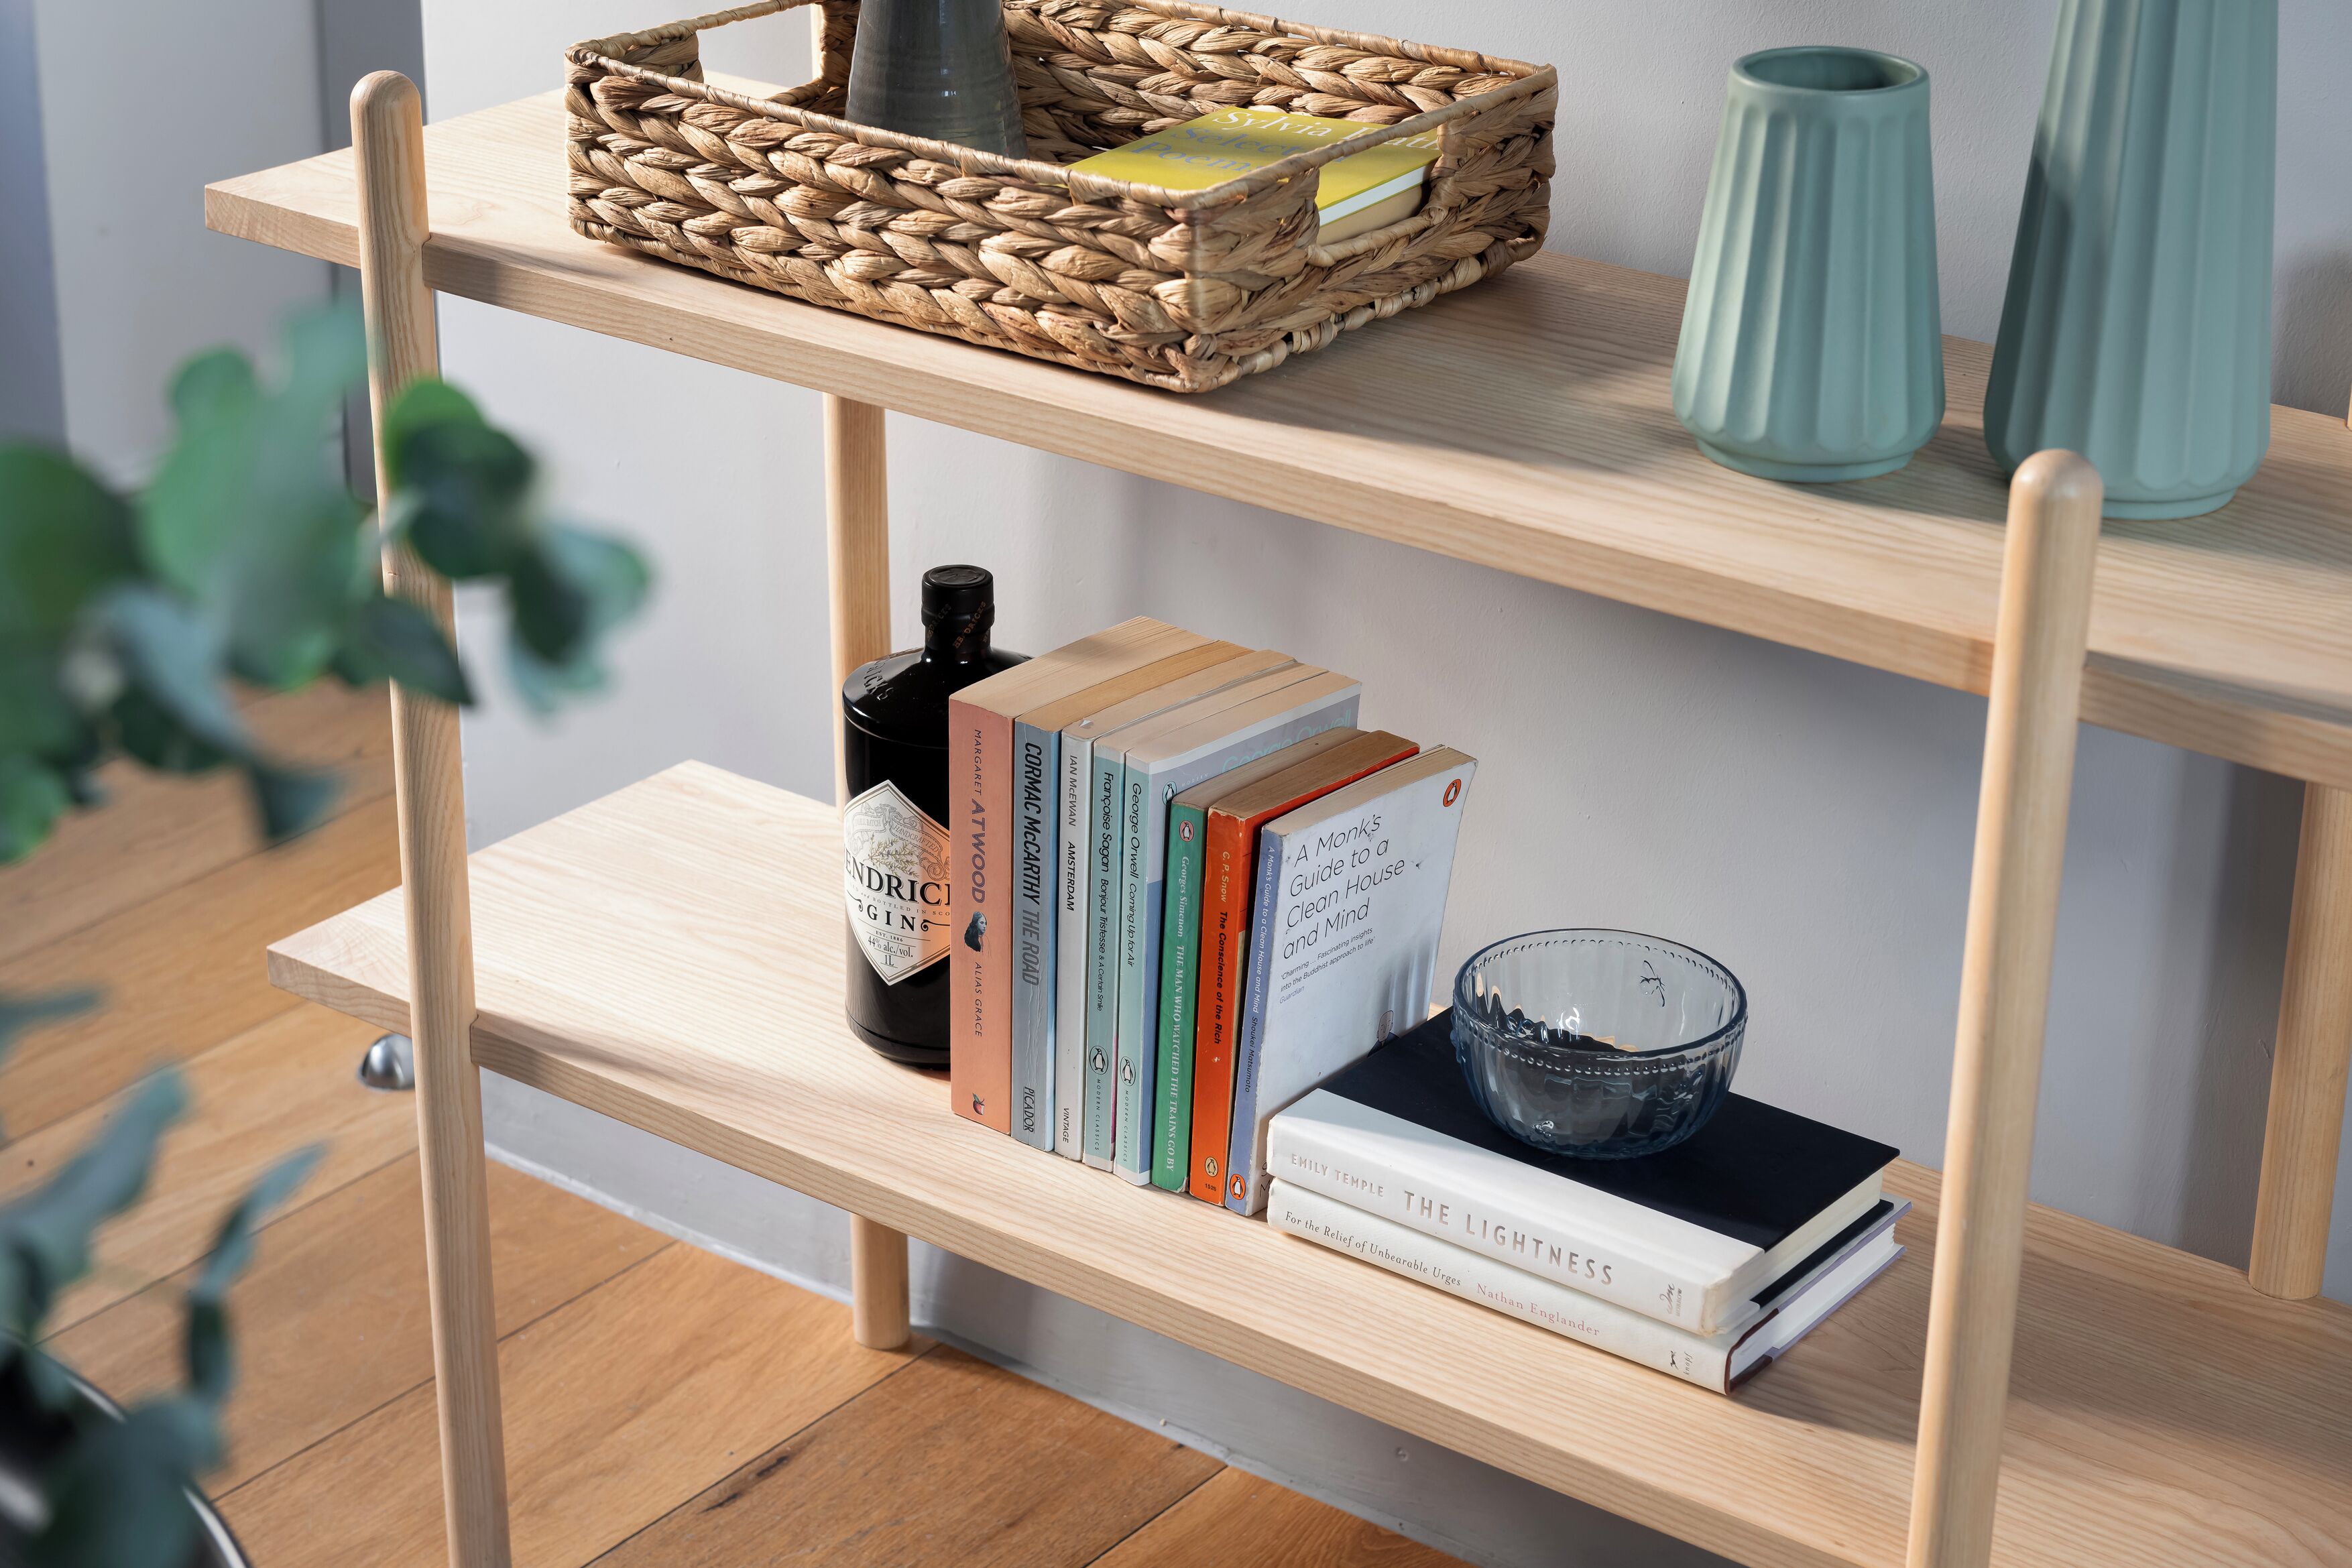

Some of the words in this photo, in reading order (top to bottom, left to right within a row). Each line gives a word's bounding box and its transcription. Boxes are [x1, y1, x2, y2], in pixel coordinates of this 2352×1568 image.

[1213, 111, 1332, 137] Sylvia
[1340, 127, 1439, 151] Path
[1132, 141, 1257, 172] Poem
[1024, 743, 1042, 815] CORMAC
[1069, 777, 1077, 827] McEWAN
[1101, 772, 1114, 830] Françoise
[1130, 783, 1142, 834] George
[893, 825, 939, 853] HANDCRAFTED
[972, 798, 986, 904] ATWOOD
[1099, 831, 1112, 873] Sagan
[1294, 844, 1307, 867] A
[1316, 815, 1381, 857] Monk's
[1023, 815, 1041, 905] McCARTHY
[1130, 837, 1140, 879] Orwell
[1222, 851, 1230, 861] C.
[1222, 863, 1230, 873] P.
[1266, 855, 1275, 882] Monk's
[1290, 859, 1344, 897] Guide
[1351, 845, 1369, 868] to
[1376, 838, 1389, 855] a
[845, 849, 950, 906] ENDRIC
[1067, 841, 1077, 911] AMSTERDAM
[1179, 856, 1189, 894] Georges
[1220, 876, 1229, 902] Snow
[873, 898, 911, 911] BOTTLED
[1100, 878, 1108, 915] Bonjour
[1127, 882, 1137, 922] Coming
[1263, 884, 1272, 906] Guide
[1287, 890, 1338, 928] Clean
[1346, 859, 1405, 899] House
[867, 904, 917, 932] GIN
[1022, 910, 1040, 941] THE
[1177, 896, 1187, 937] Simenon
[1219, 911, 1228, 929] The
[1262, 908, 1269, 916] to
[1283, 927, 1318, 959] and
[1325, 898, 1369, 937] Mind
[868, 935, 882, 949] 44%
[883, 942, 913, 957] alc./vol.
[1100, 916, 1108, 953] Tristesse
[1127, 924, 1135, 939] Up
[1259, 926, 1267, 949] Clean
[1317, 939, 1349, 961] Fascinating
[1350, 928, 1373, 944] insights
[885, 955, 894, 966] 1L
[1022, 941, 1040, 986] ROAD
[1175, 945, 1185, 964] THE
[1216, 932, 1227, 989] Conscience
[1256, 950, 1266, 975] House
[1281, 981, 1291, 992] into
[1293, 975, 1302, 987] the
[1303, 961, 1328, 983] Buddhist
[1329, 947, 1356, 967] approach
[1358, 942, 1364, 950] to
[1175, 968, 1183, 993] MAN
[1216, 991, 1224, 1003] of
[1279, 986, 1304, 1004] Guardian
[1173, 995, 1182, 1022] WHO
[1215, 1007, 1223, 1022] the
[1252, 991, 1261, 1013] Mind
[1214, 1024, 1222, 1044] Rich
[1249, 1016, 1258, 1046] Shoukei
[1171, 1024, 1181, 1075] WATCHED
[1170, 1077, 1179, 1097] THE
[1245, 1048, 1255, 1093] Matsumoto
[1023, 1087, 1035, 1134] PICADOR
[1169, 1099, 1178, 1143] TRAINS
[1167, 1144, 1175, 1156] GO
[1167, 1158, 1175, 1171] BY
[1291, 1153, 1328, 1176] EMILY
[1335, 1169, 1385, 1198] TEMPLE
[1404, 1190, 1450, 1225] THE
[1466, 1213, 1612, 1286] LIGHTNESS
[1285, 1211, 1301, 1226] For
[1305, 1220, 1320, 1233] the
[1324, 1225, 1354, 1248] Relief
[1356, 1239, 1367, 1253] of
[1370, 1244, 1428, 1274] Unbearable
[1433, 1267, 1462, 1286] Urges
[1476, 1283, 1524, 1311] Nathan
[1531, 1303, 1600, 1337] Englander
